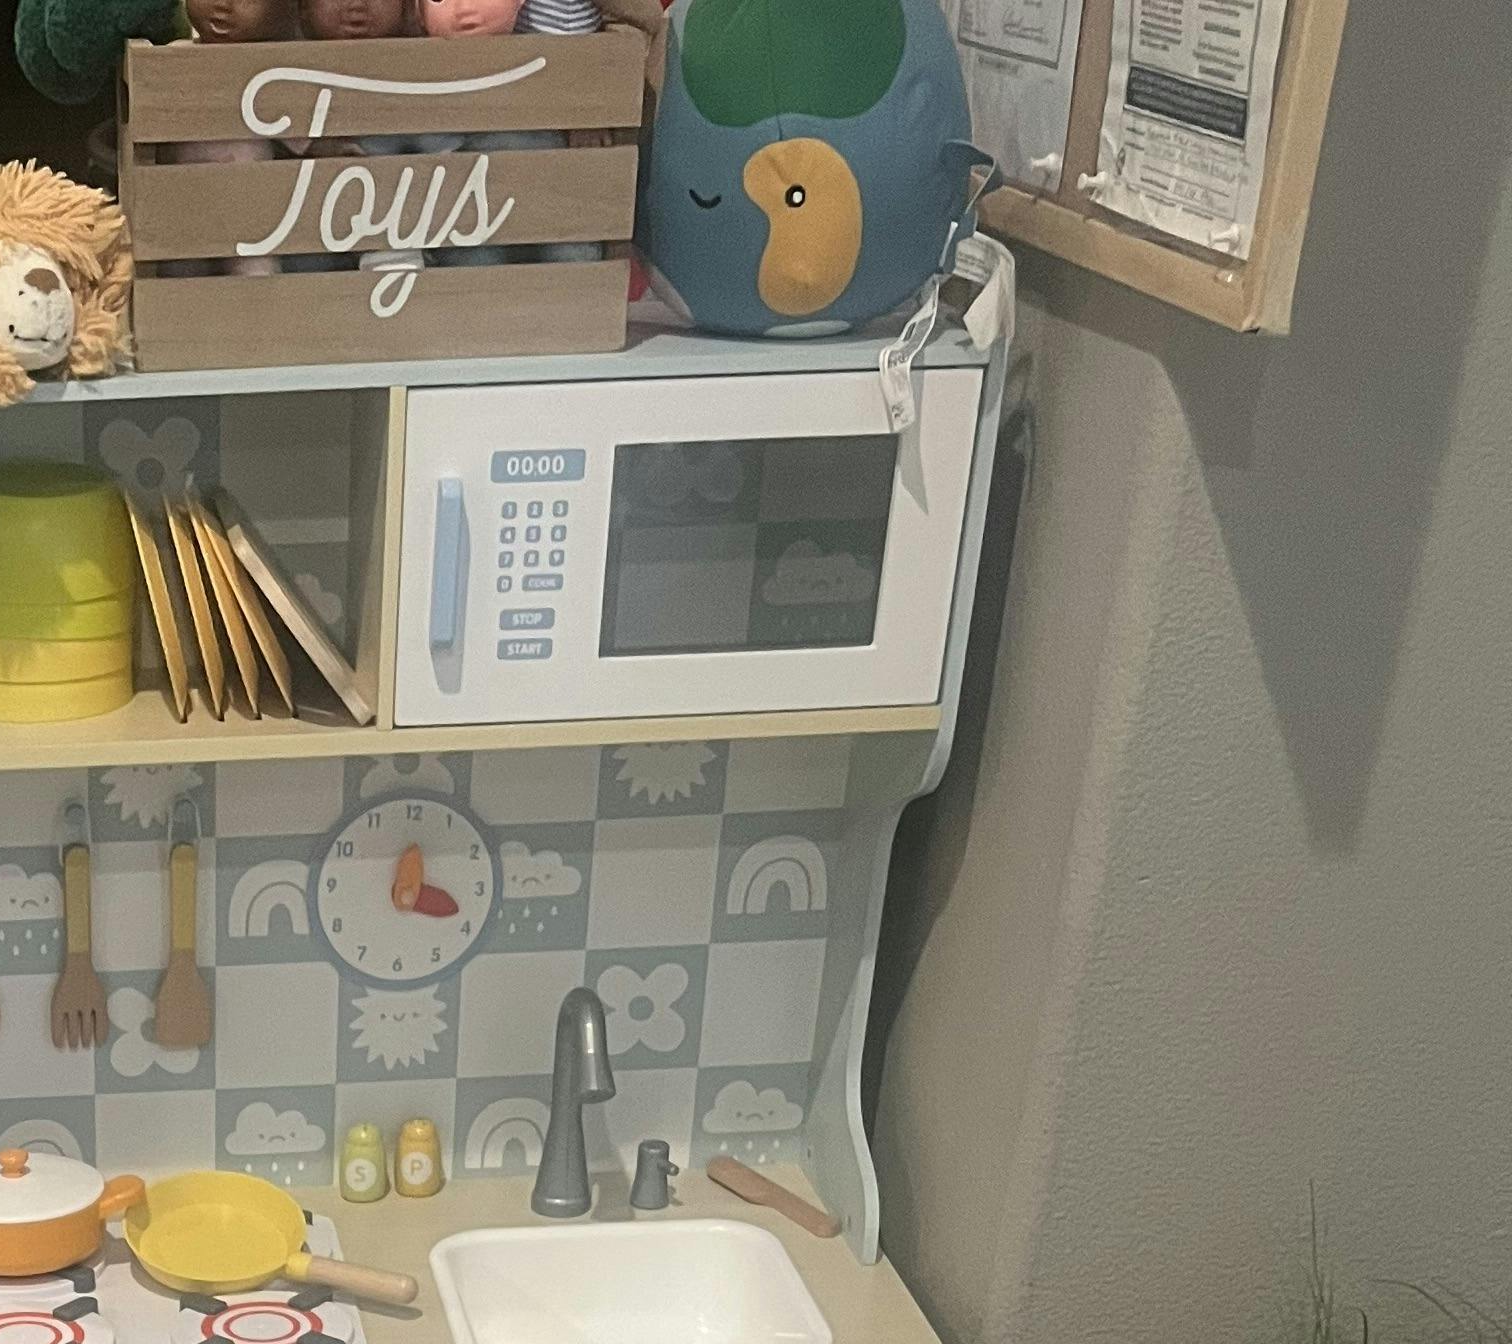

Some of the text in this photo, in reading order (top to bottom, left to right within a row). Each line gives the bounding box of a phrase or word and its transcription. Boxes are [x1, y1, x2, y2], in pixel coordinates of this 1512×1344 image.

[236, 56, 546, 318] Toys
[500, 578, 510, 590] 0
[512, 612, 543, 626] STOP
[507, 642, 543, 656] START
[406, 804, 423, 821] 12
[367, 813, 381, 829] 11
[445, 813, 452, 829] 1
[336, 841, 354, 858] 10
[469, 844, 480, 860] 2
[326, 878, 337, 893] 9
[474, 881, 485, 897] 3
[332, 918, 342, 933] 8
[460, 920, 471, 936] 4
[357, 945, 367, 961] 7
[431, 948, 441, 963] 5
[392, 957, 403, 972] 6
[354, 1165, 366, 1183] S
[410, 1159, 424, 1177] P
